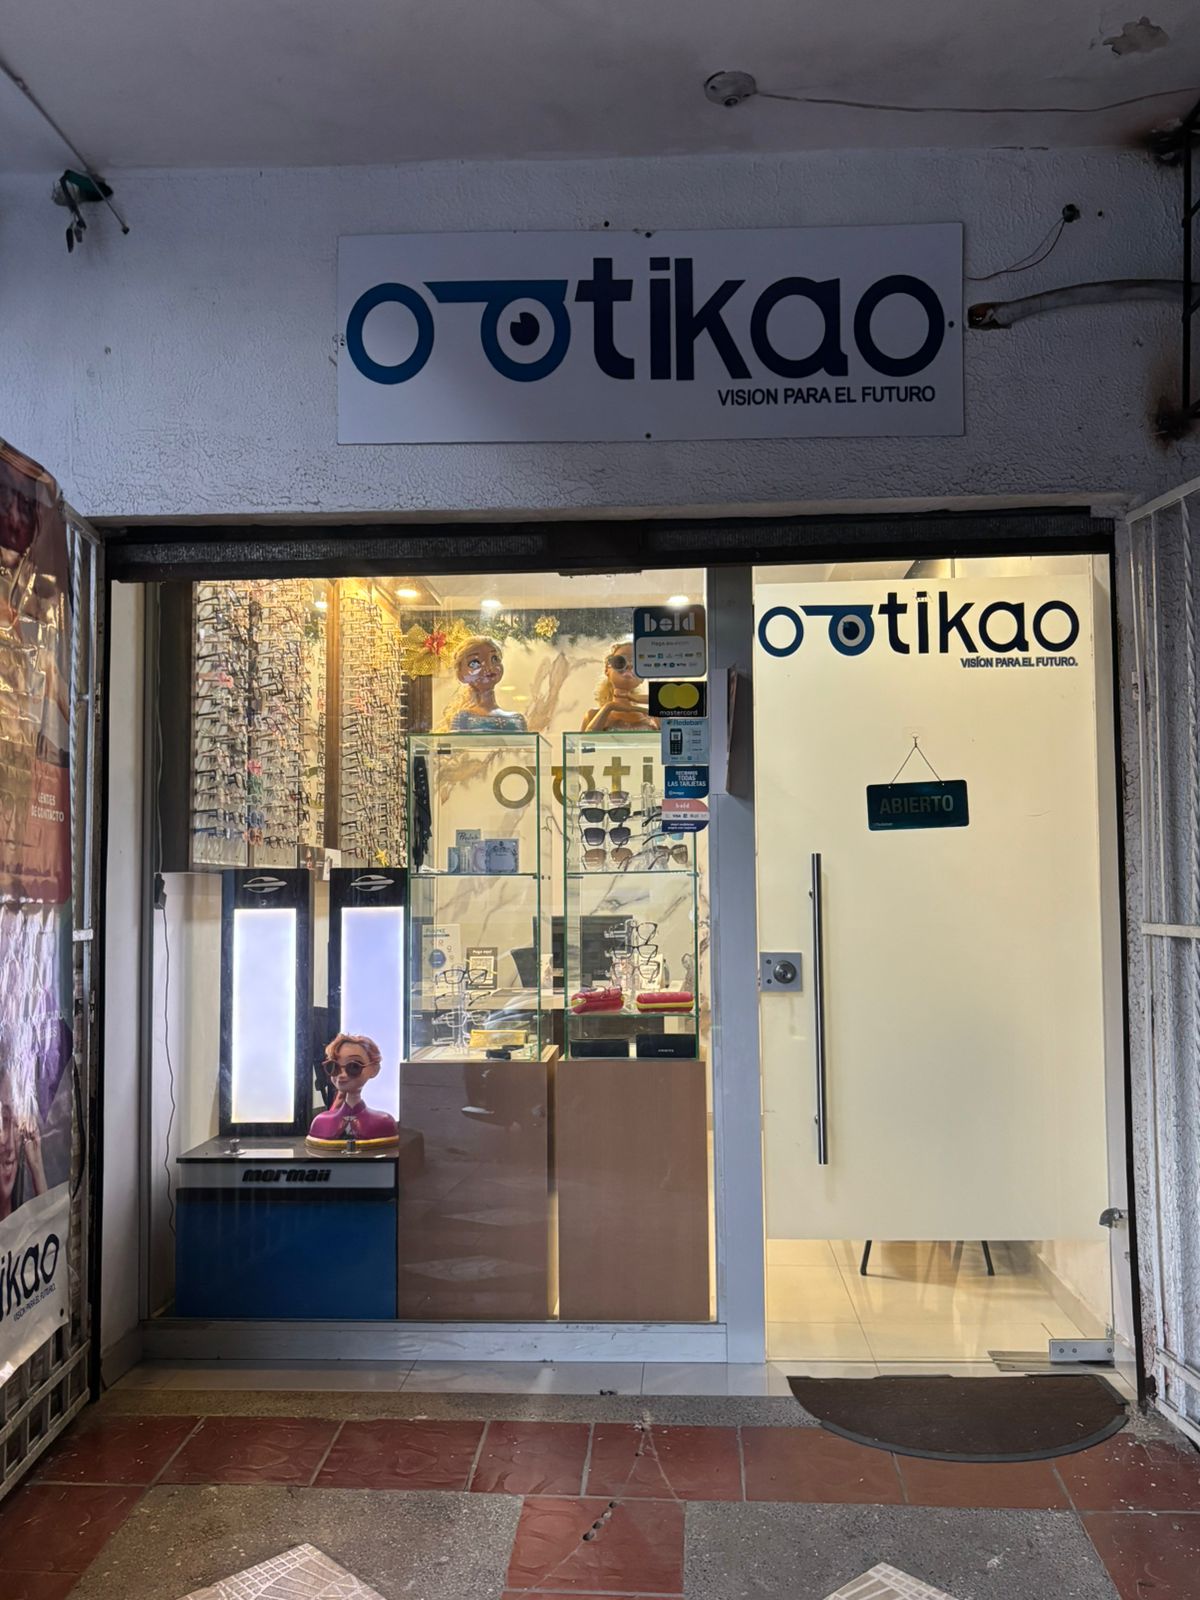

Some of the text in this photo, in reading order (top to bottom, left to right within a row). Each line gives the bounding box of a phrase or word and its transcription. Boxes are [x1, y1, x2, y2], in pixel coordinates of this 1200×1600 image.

[718, 385, 936, 406] VISION PARA EL FUTURO
[644, 611, 695, 632] bold
[995, 656, 1021, 667] PARA
[1022, 656, 1034, 667] EL
[880, 795, 954, 814] ABIERTO
[242, 1168, 332, 1183] mormaii
